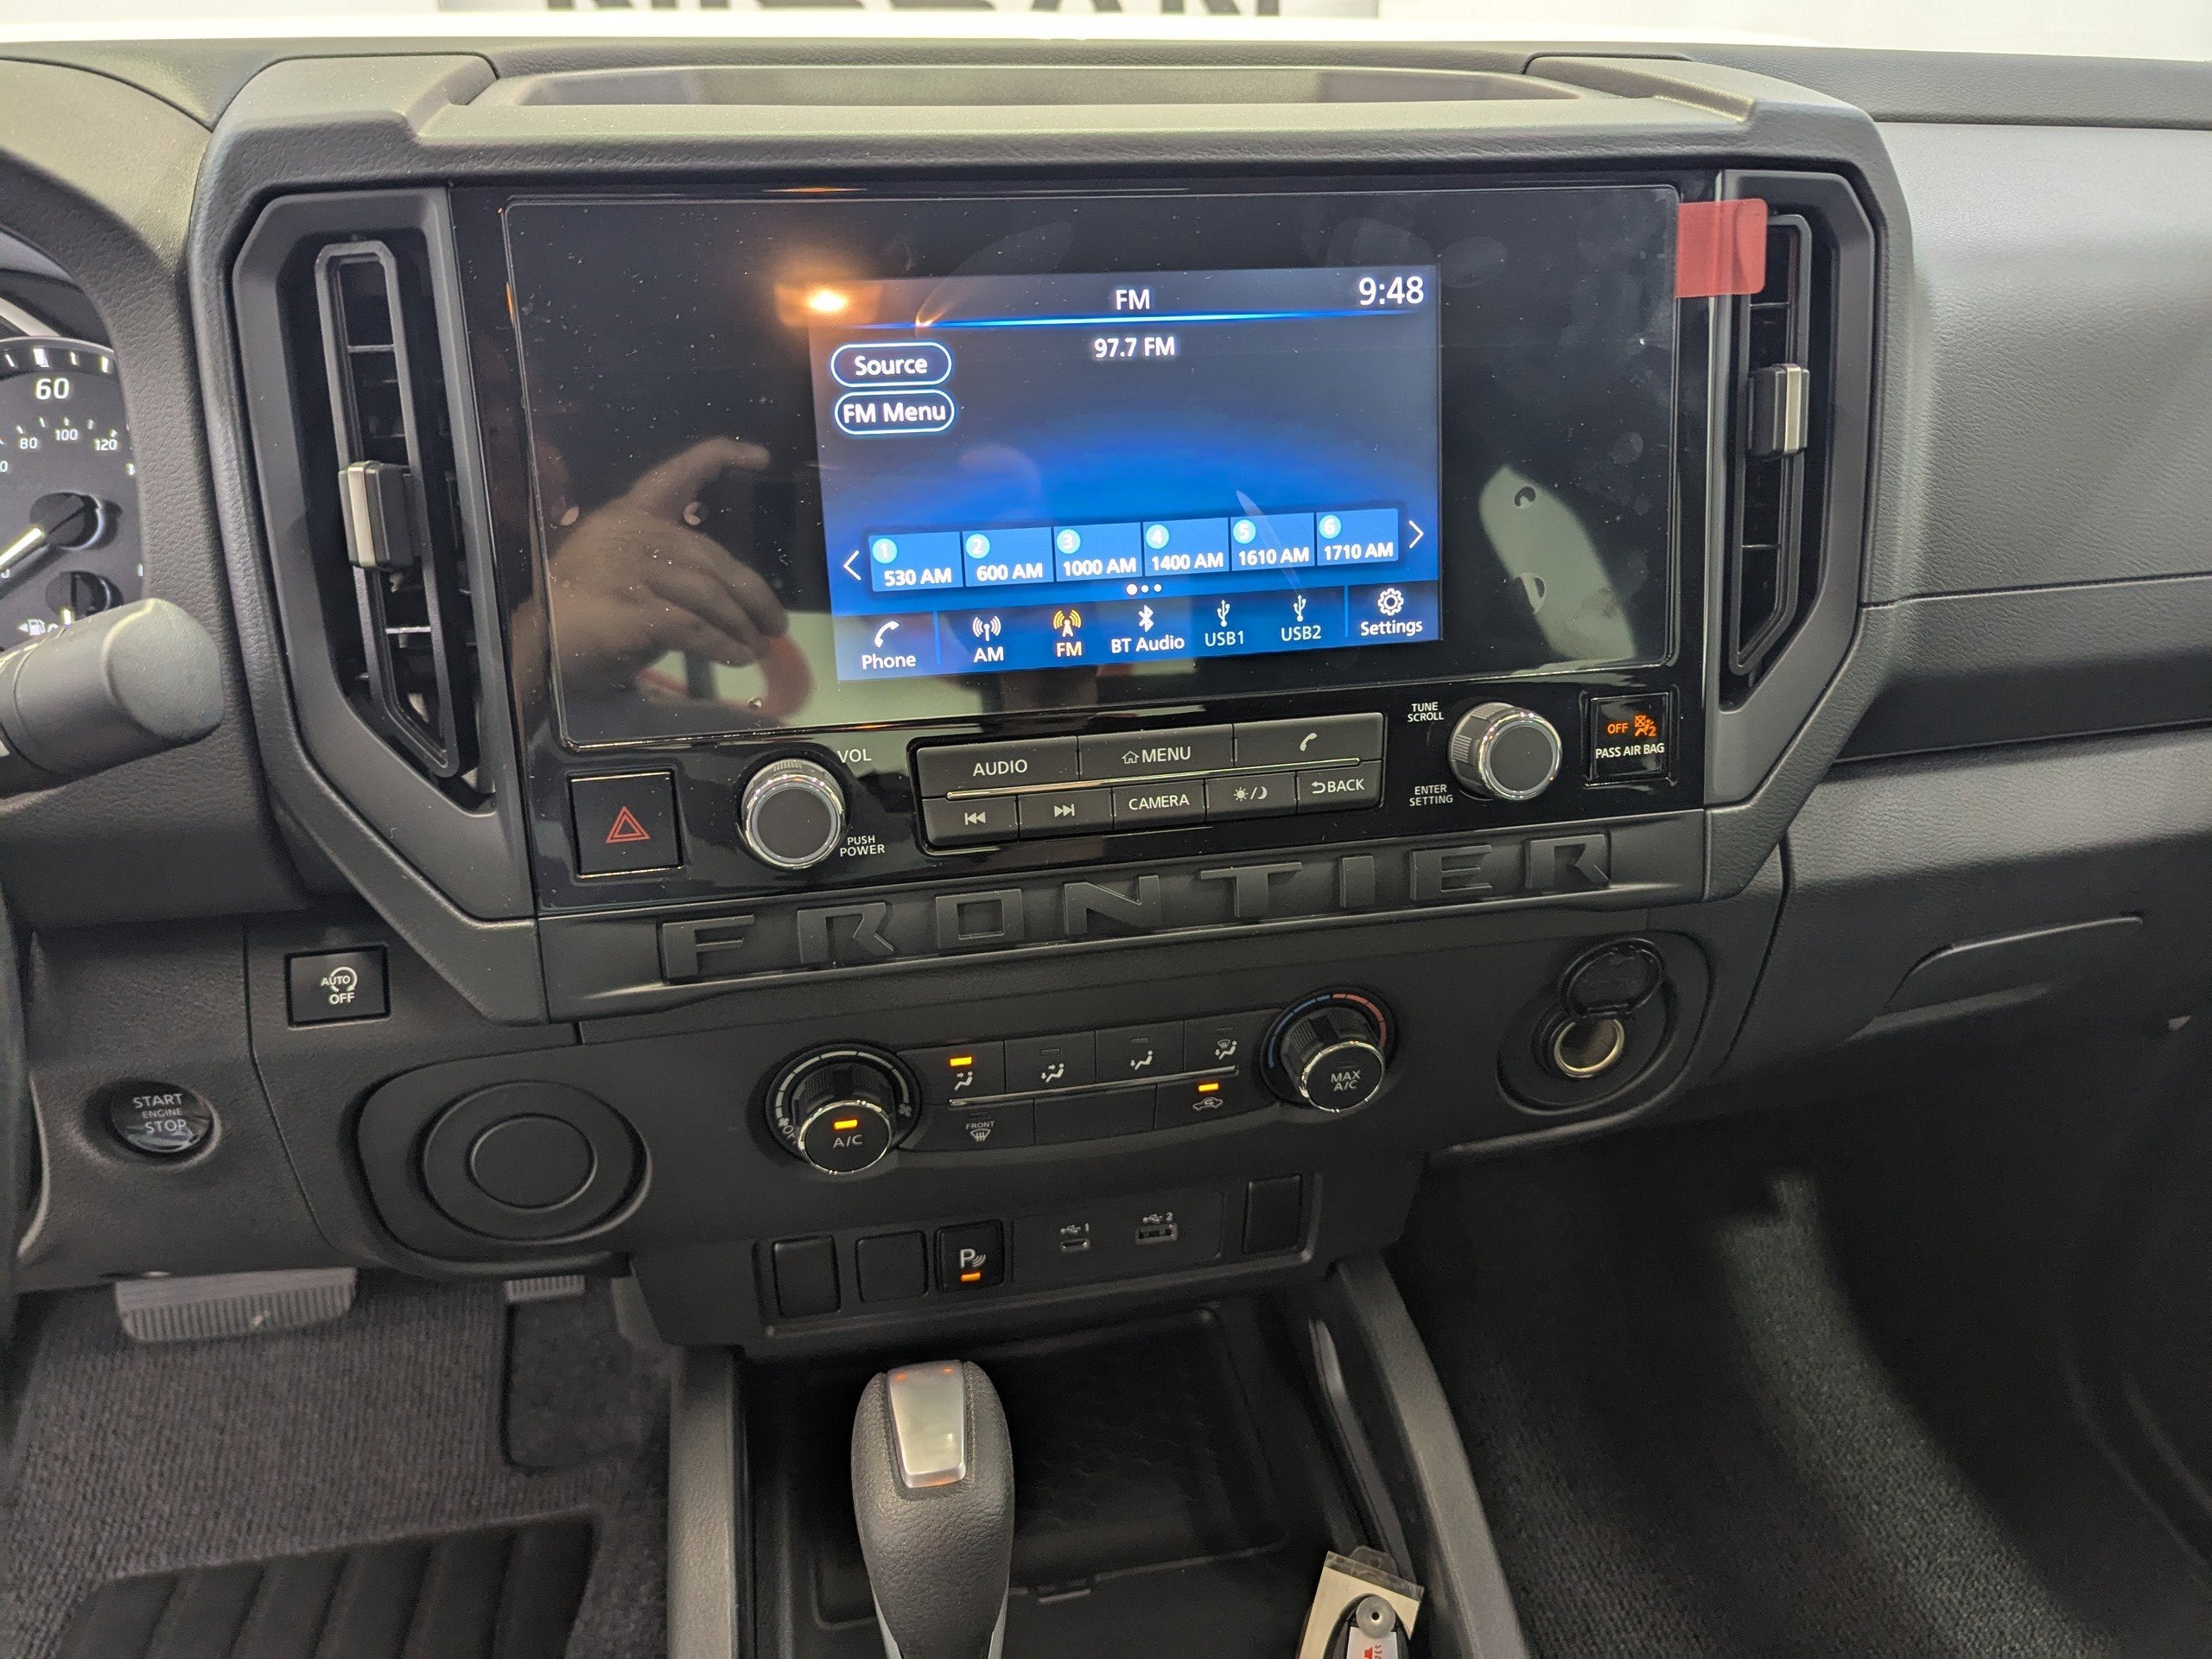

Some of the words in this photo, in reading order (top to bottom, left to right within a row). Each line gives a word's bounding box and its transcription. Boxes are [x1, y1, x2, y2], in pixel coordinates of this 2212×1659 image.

[1116, 289, 1151, 310] FM
[1357, 276, 1425, 306] 9:48
[1094, 337, 1137, 359] 97.7
[1143, 336, 1175, 357] FM
[854, 355, 928, 377] Source
[35, 377, 70, 400] 60
[842, 403, 877, 423] FM
[883, 402, 946, 423] Menu
[19, 437, 38, 449] 80
[54, 429, 79, 441] 100
[94, 437, 118, 451] 120
[1239, 524, 1249, 539] 5
[1324, 519, 1336, 534] 6
[1063, 534, 1074, 550] 3
[1151, 529, 1164, 544] 4
[971, 537, 983, 554] 2
[1324, 544, 1362, 561] 1710
[1364, 542, 1394, 558] AM
[1151, 554, 1191, 571] 1400
[1193, 552, 1224, 569] AM
[1238, 549, 1277, 566] 1610
[1280, 547, 1309, 563] AM
[976, 564, 1008, 582] 600
[1012, 563, 1043, 580] AM
[1063, 560, 1103, 577] 1000
[1106, 557, 1137, 575] AM
[884, 569, 916, 588] 530
[920, 568, 952, 585] AM
[1281, 625, 1322, 642] USB2
[1360, 619, 1424, 640] Settings
[1111, 638, 1133, 654] BT
[1135, 635, 1185, 652] Audio
[1204, 630, 1244, 647] USB1
[973, 646, 1004, 663] AM
[1056, 641, 1083, 658] FM
[861, 653, 917, 671] Phone
[1411, 702, 1439, 712] TUNE
[1407, 710, 1444, 722] SCROLL
[1606, 722, 1629, 734] OFF
[836, 748, 872, 764] VOL
[1141, 745, 1192, 763] MENU
[1595, 747, 1621, 759] PASS
[1623, 746, 1641, 757] AIR
[1643, 743, 1665, 755] BAG
[973, 759, 1028, 777] AUDIO
[1327, 778, 1365, 792] BACK
[1414, 784, 1447, 795] ENTER
[1128, 793, 1190, 811] CAMERA
[1409, 794, 1453, 807] SETTING
[847, 835, 875, 846] PUSH
[839, 844, 886, 858] POWER
[662, 833, 1611, 979] FRONTIER
[321, 975, 351, 987] AUTO
[328, 992, 355, 1005] OFF
[1330, 1069, 1362, 1083] MAX
[1333, 1080, 1357, 1092] A/C
[133, 1092, 183, 1109] START
[142, 1107, 183, 1119] ENGINE
[144, 1119, 188, 1135] STOP
[965, 1120, 995, 1130] FRONT
[832, 1134, 863, 1148] A/C
[960, 1248, 976, 1268] P
